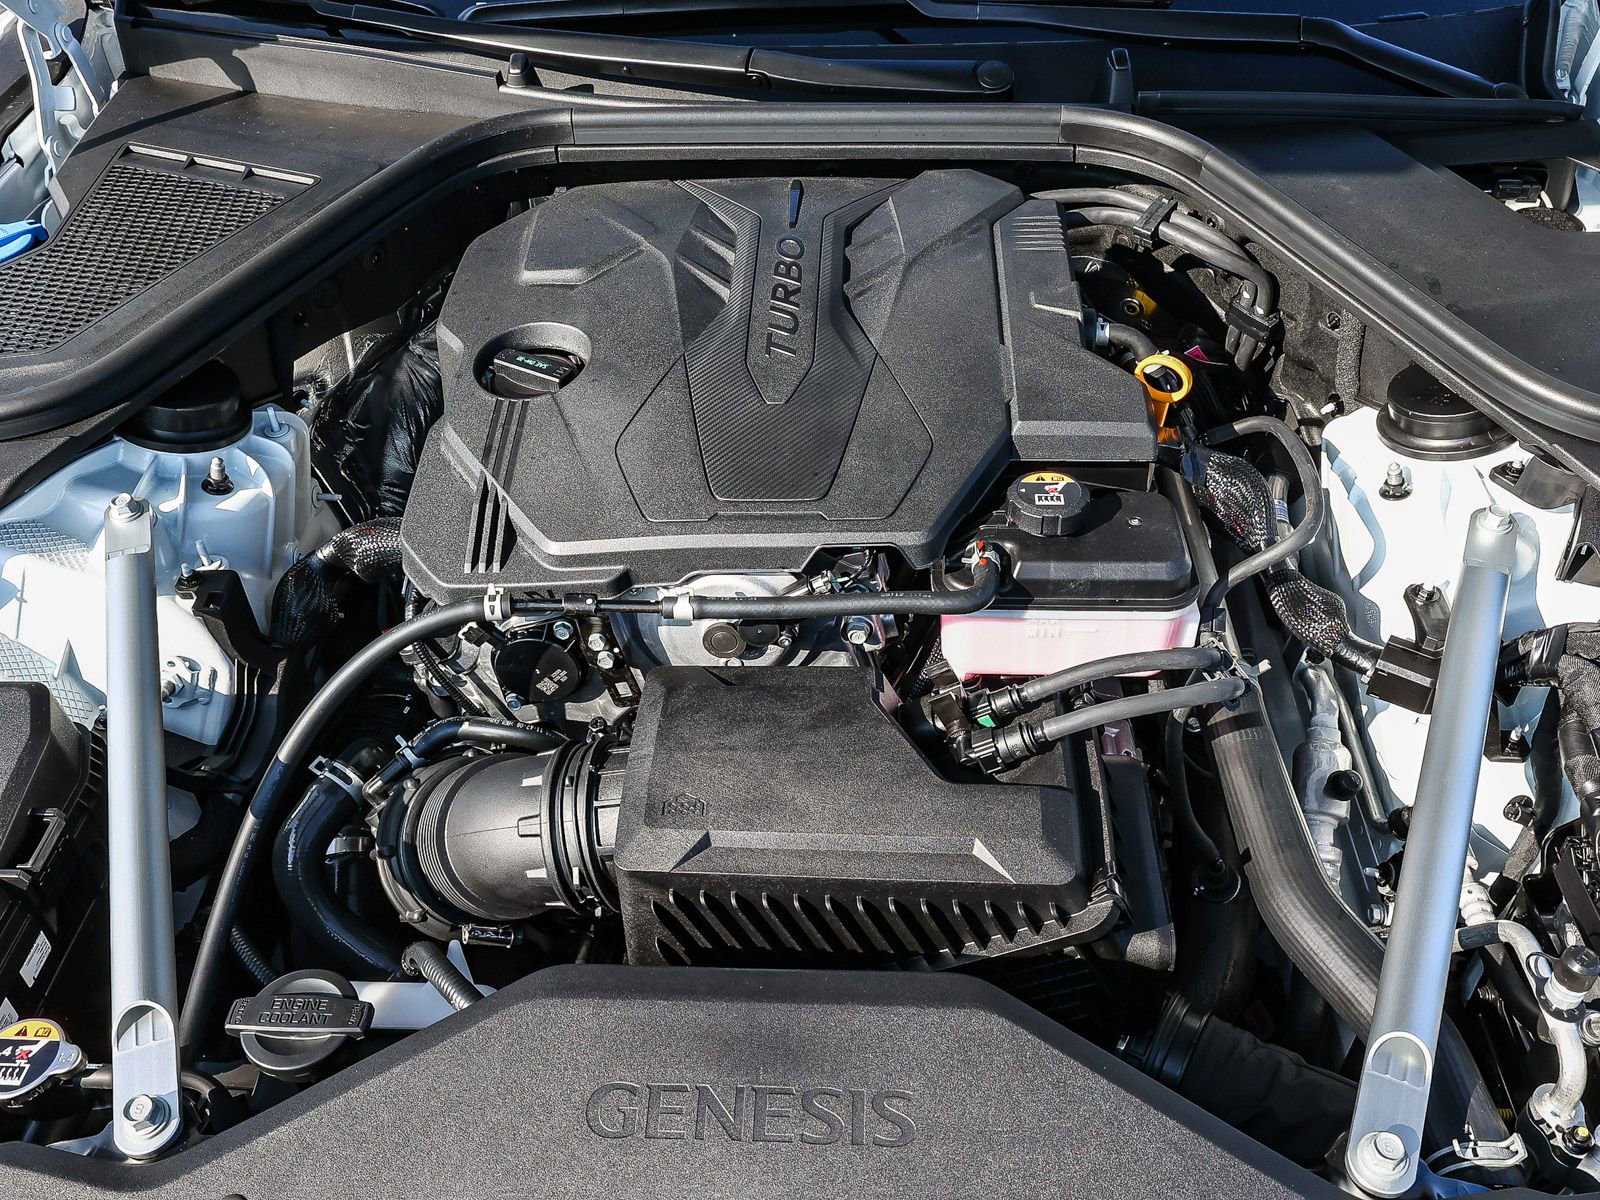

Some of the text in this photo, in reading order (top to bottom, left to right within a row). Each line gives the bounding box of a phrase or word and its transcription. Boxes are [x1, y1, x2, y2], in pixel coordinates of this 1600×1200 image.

[764, 234, 805, 358] TURBO
[258, 1011, 333, 1025] COOLANT
[271, 998, 329, 1011] ENGINE
[585, 1081, 917, 1148] GENESIS
